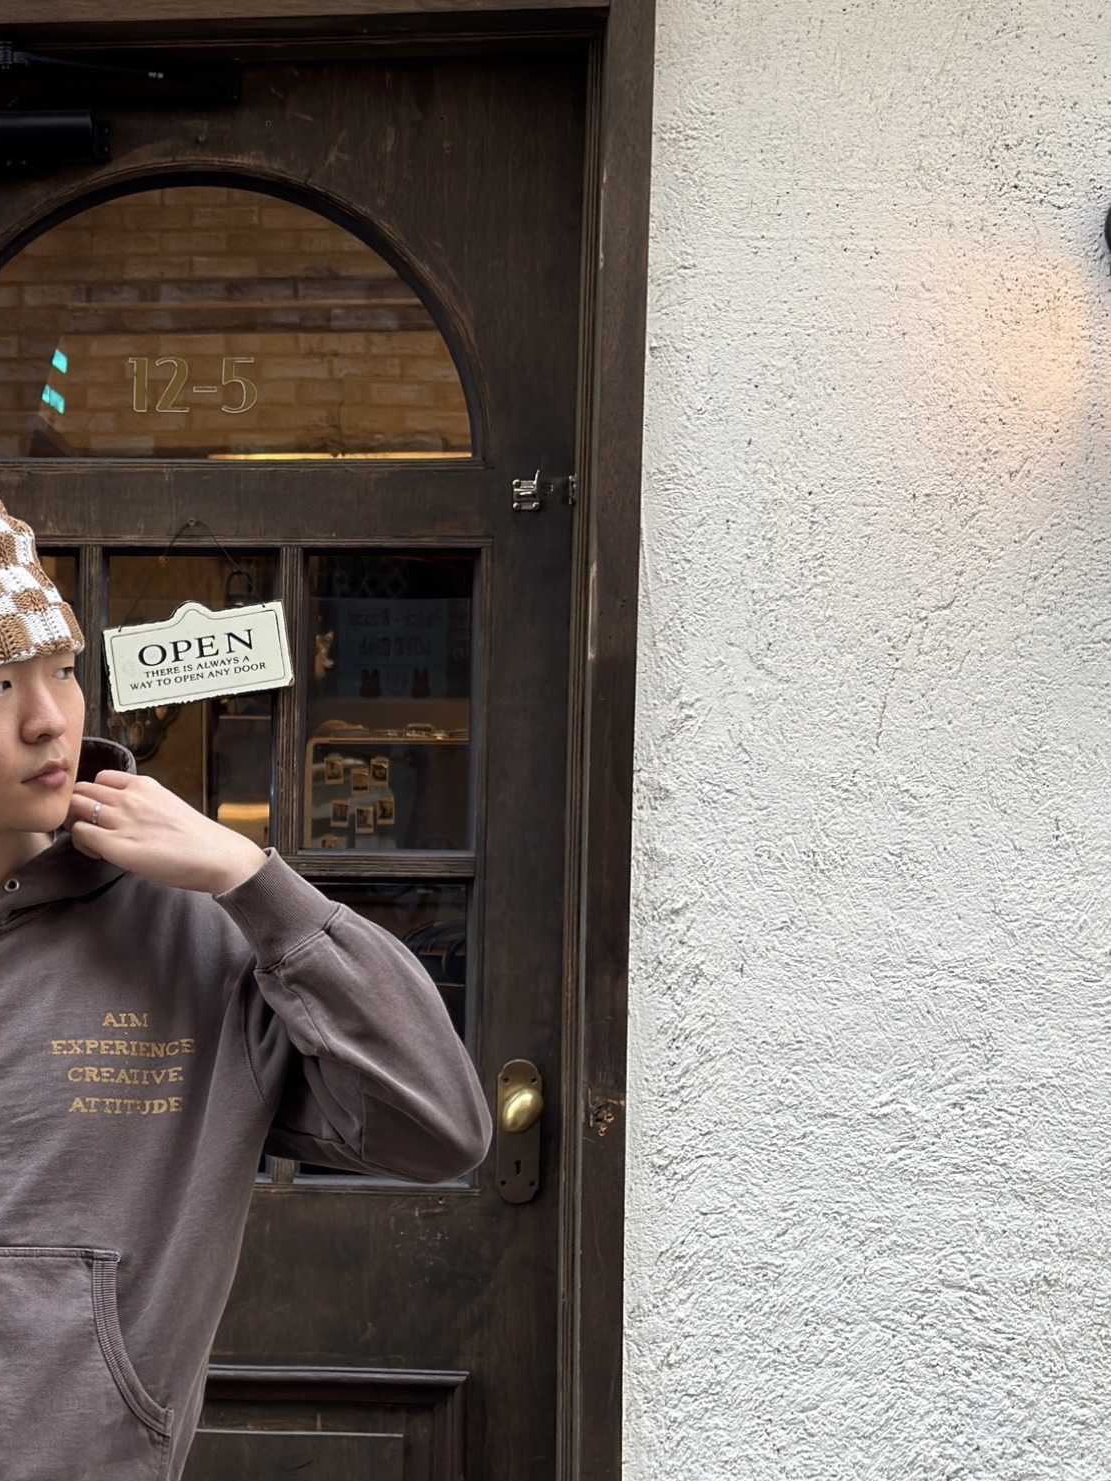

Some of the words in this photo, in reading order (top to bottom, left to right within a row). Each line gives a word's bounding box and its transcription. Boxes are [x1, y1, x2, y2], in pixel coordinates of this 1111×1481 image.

[128, 356, 258, 414] 12-5
[138, 628, 254, 667] OPEN
[129, 680, 153, 691] WAY
[156, 678, 171, 687] TO
[174, 672, 204, 684] OPEN
[207, 668, 230, 679] ANY
[234, 661, 266, 673] DOOR
[144, 666, 180, 678] THERE
[183, 664, 193, 672] IS
[196, 656, 239, 670] ALWAYS
[242, 655, 250, 663] A
[102, 1012, 149, 1028] AIM
[51, 1038, 196, 1059] EXPERIENCE
[67, 1066, 184, 1086] CREATIVE
[67, 1096, 184, 1116] ATTITUDE
